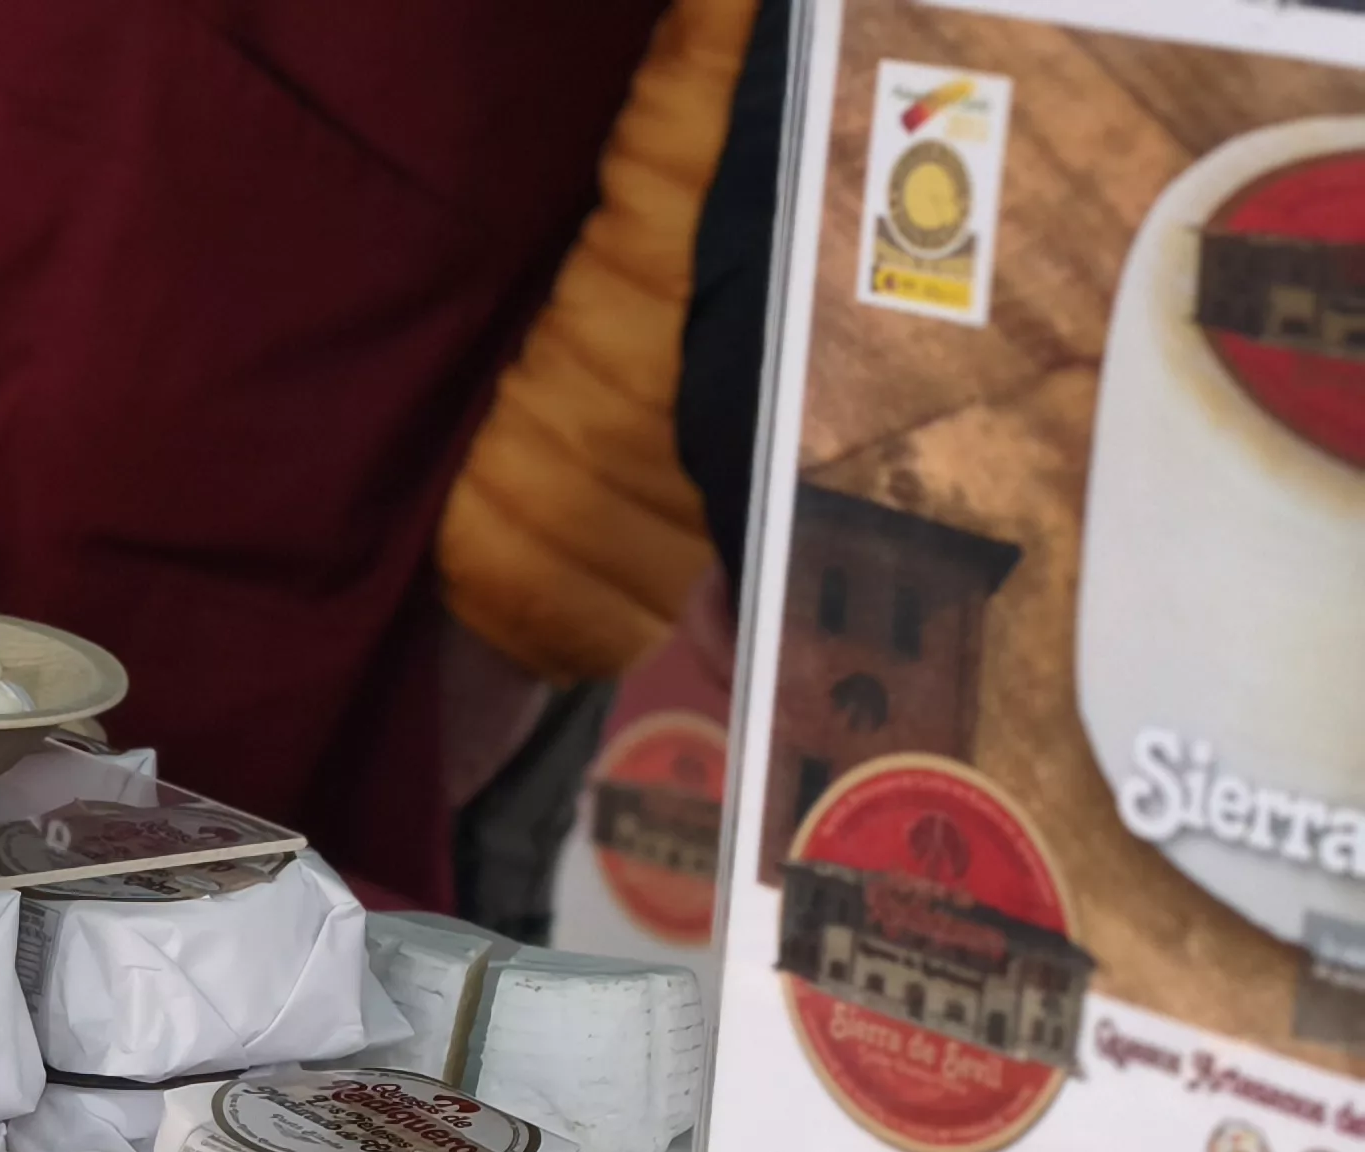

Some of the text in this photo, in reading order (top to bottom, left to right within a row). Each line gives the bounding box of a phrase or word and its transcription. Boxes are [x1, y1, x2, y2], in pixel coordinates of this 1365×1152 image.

[1116, 727, 1365, 876] Sierra
[306, 1095, 347, 1116] Los
[371, 1083, 472, 1129] Quesos de
